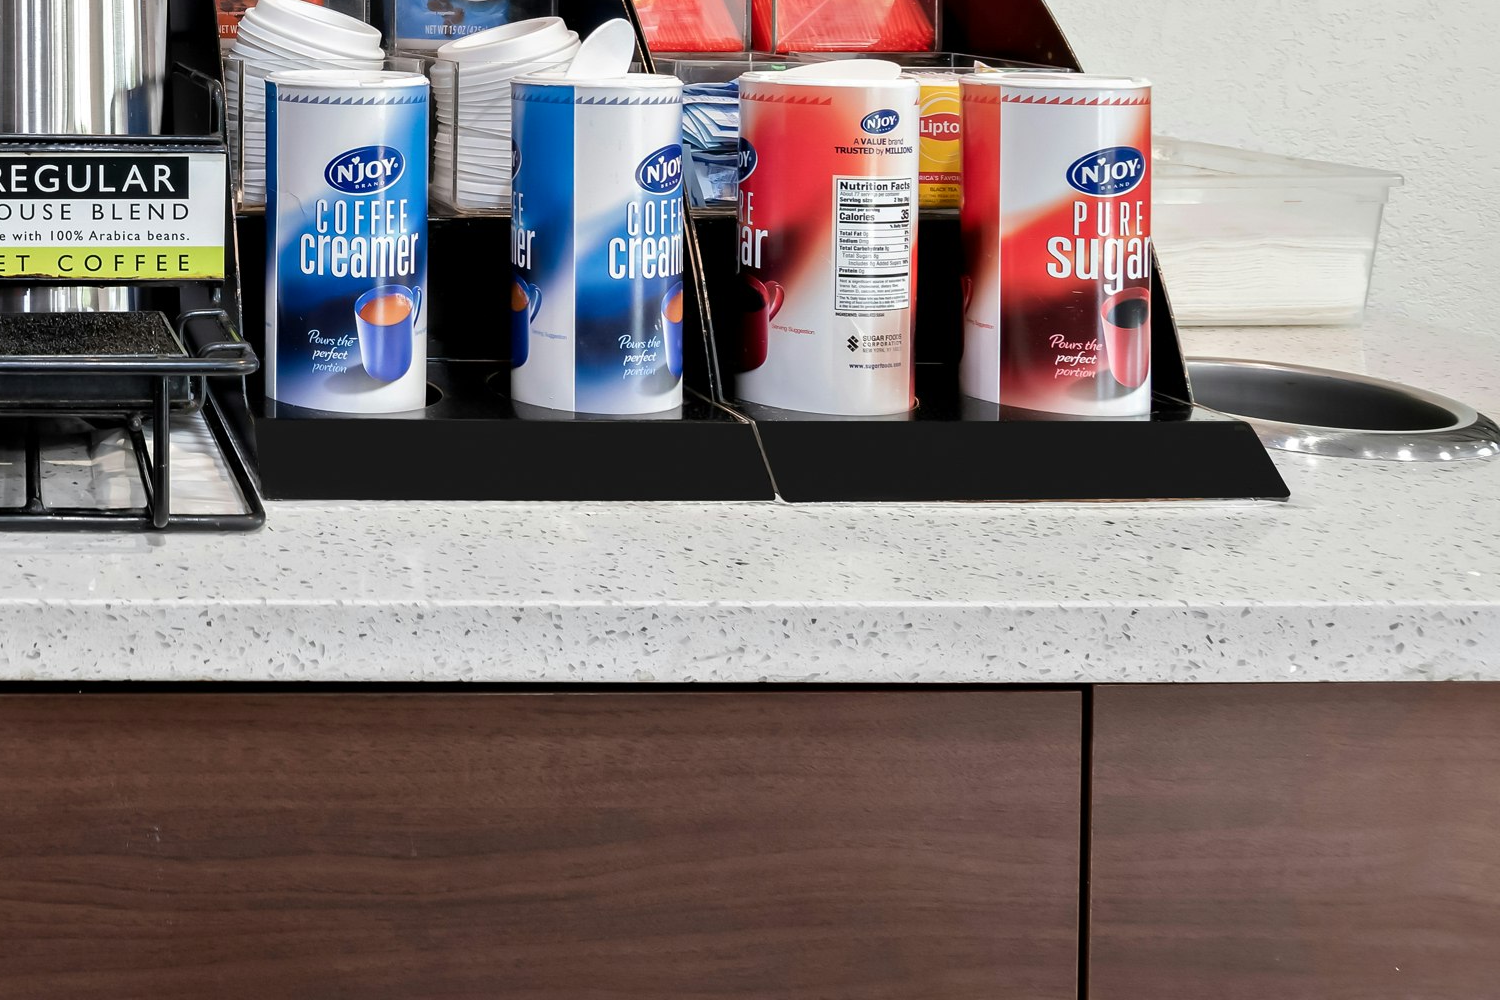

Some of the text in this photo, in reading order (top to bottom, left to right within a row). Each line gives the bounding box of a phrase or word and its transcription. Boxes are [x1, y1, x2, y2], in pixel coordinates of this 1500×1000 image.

[425, 25, 466, 35] NET WT 15 OZ
[920, 120, 960, 136] Lipto
[835, 146, 913, 156] TRUSTED by MILLIONS
[355, 181, 385, 189] BRAND
[660, 178, 679, 189] BRAND
[839, 181, 910, 191] Nutrition Facts
[1101, 181, 1130, 191] BRAND
[92, 203, 189, 221] BLEND
[315, 199, 408, 235] COFFEE
[627, 197, 683, 236] COFFE
[839, 213, 875, 221] Calories
[1073, 201, 1143, 237] PURE
[12, 230, 42, 242] with
[49, 230, 84, 242] 100%
[88, 230, 141, 242] Arabica
[147, 230, 190, 242] beans.
[300, 232, 419, 279] creamer
[608, 234, 683, 280] cream
[57, 254, 190, 273] COFFEE
[1046, 234, 1151, 296] sugar
[307, 329, 354, 347] Pours the
[618, 334, 661, 350] Pours the
[1049, 334, 1103, 351] Pours the
[312, 348, 348, 363] perfect
[623, 351, 657, 367] perfect
[1055, 352, 1098, 365] perfect
[312, 362, 347, 374] portion
[623, 365, 656, 379] portion
[1054, 366, 1096, 379] portion
